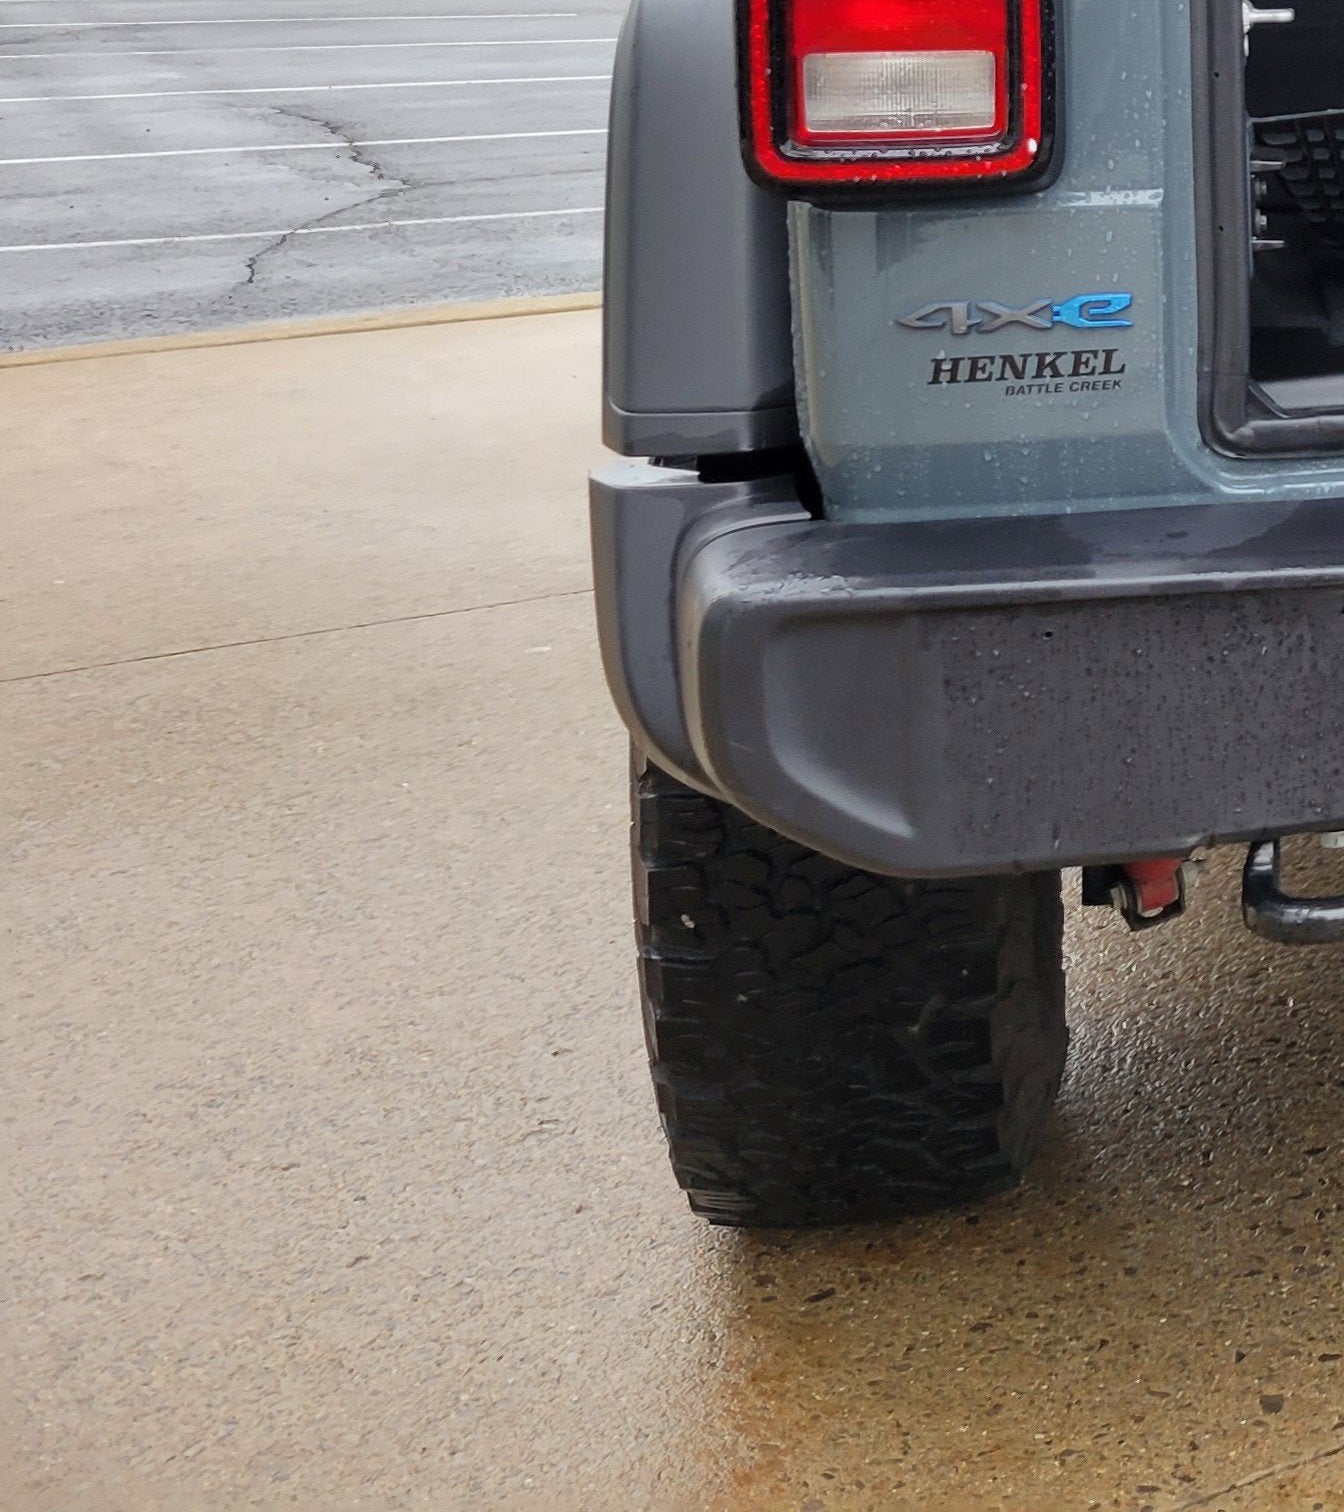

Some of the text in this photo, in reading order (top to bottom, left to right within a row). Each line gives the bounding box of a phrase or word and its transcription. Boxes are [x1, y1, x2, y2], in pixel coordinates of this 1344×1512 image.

[927, 348, 1126, 385] HENKEL
[1005, 379, 1122, 396] BATTLE CREEK
